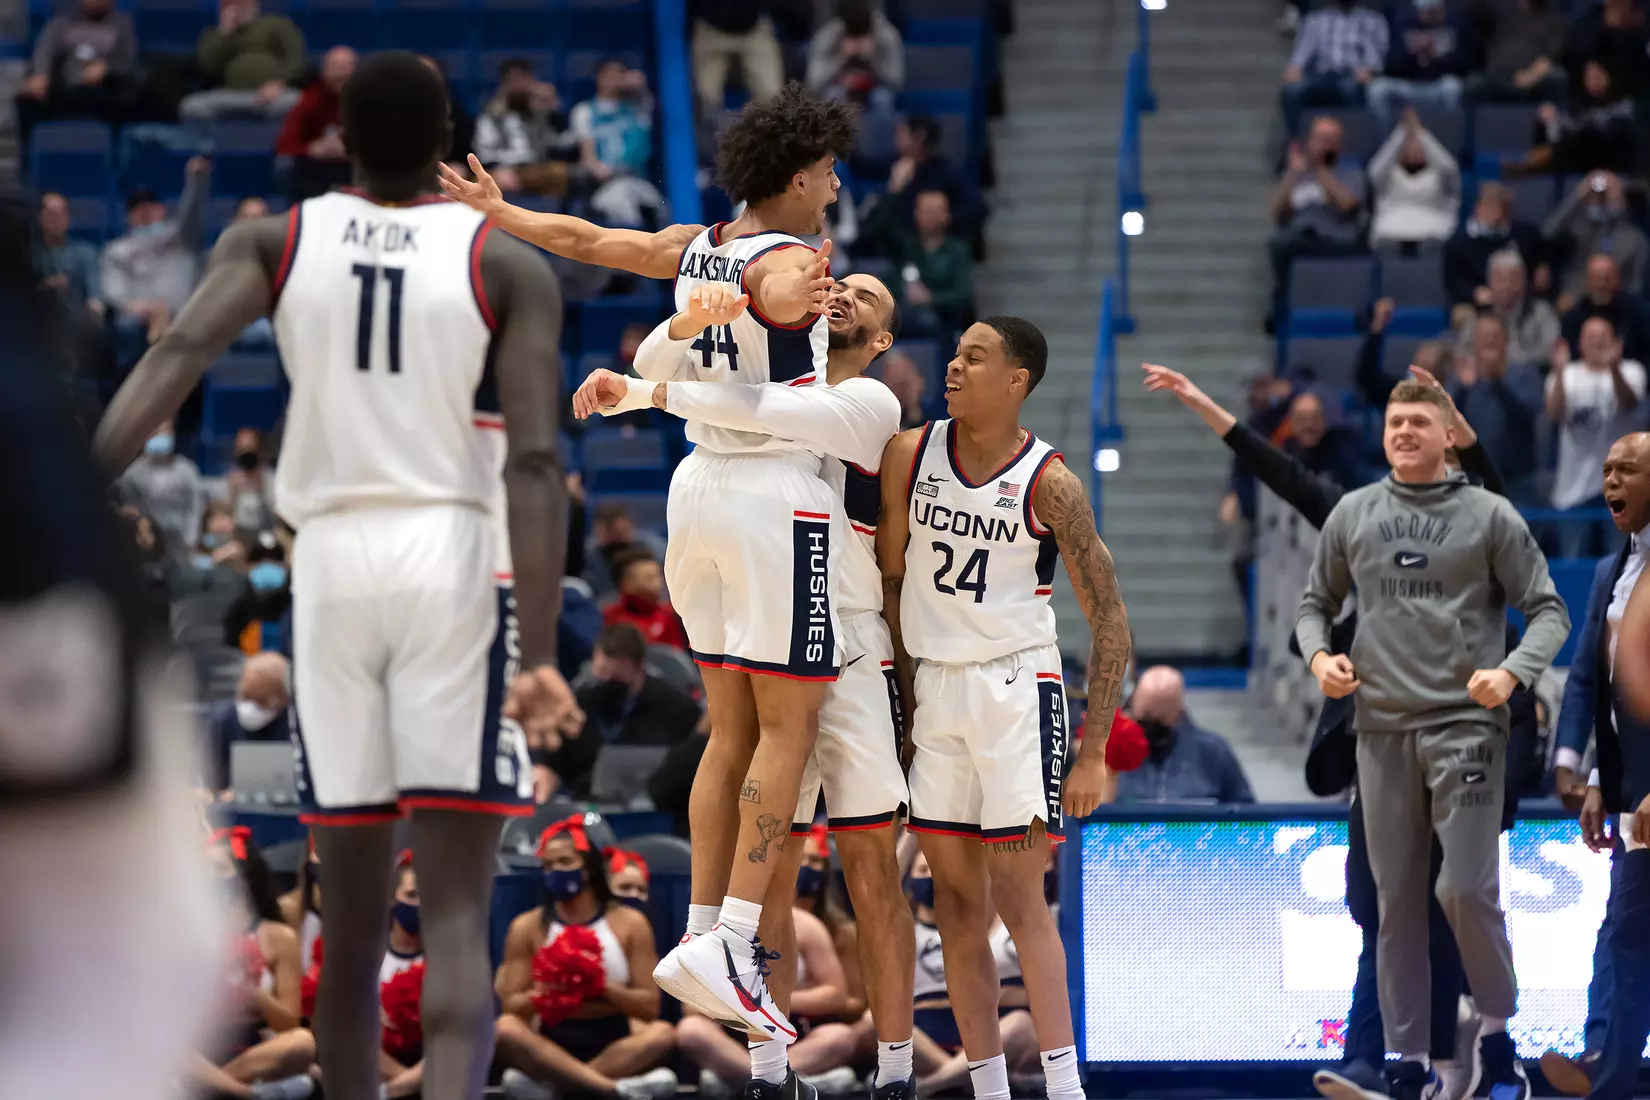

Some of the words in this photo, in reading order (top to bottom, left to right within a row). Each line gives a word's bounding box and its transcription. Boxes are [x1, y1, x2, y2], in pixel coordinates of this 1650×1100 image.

[341, 217, 421, 253] AKOK
[351, 263, 405, 374] 11
[690, 323, 739, 371] 44
[915, 498, 1019, 543] UCONN
[1378, 513, 1453, 547] UCONN
[931, 540, 990, 603] 24
[1380, 576, 1444, 600] HUSKIES
[806, 532, 826, 662] HUSKIES
[1048, 691, 1063, 820] HUSKIES
